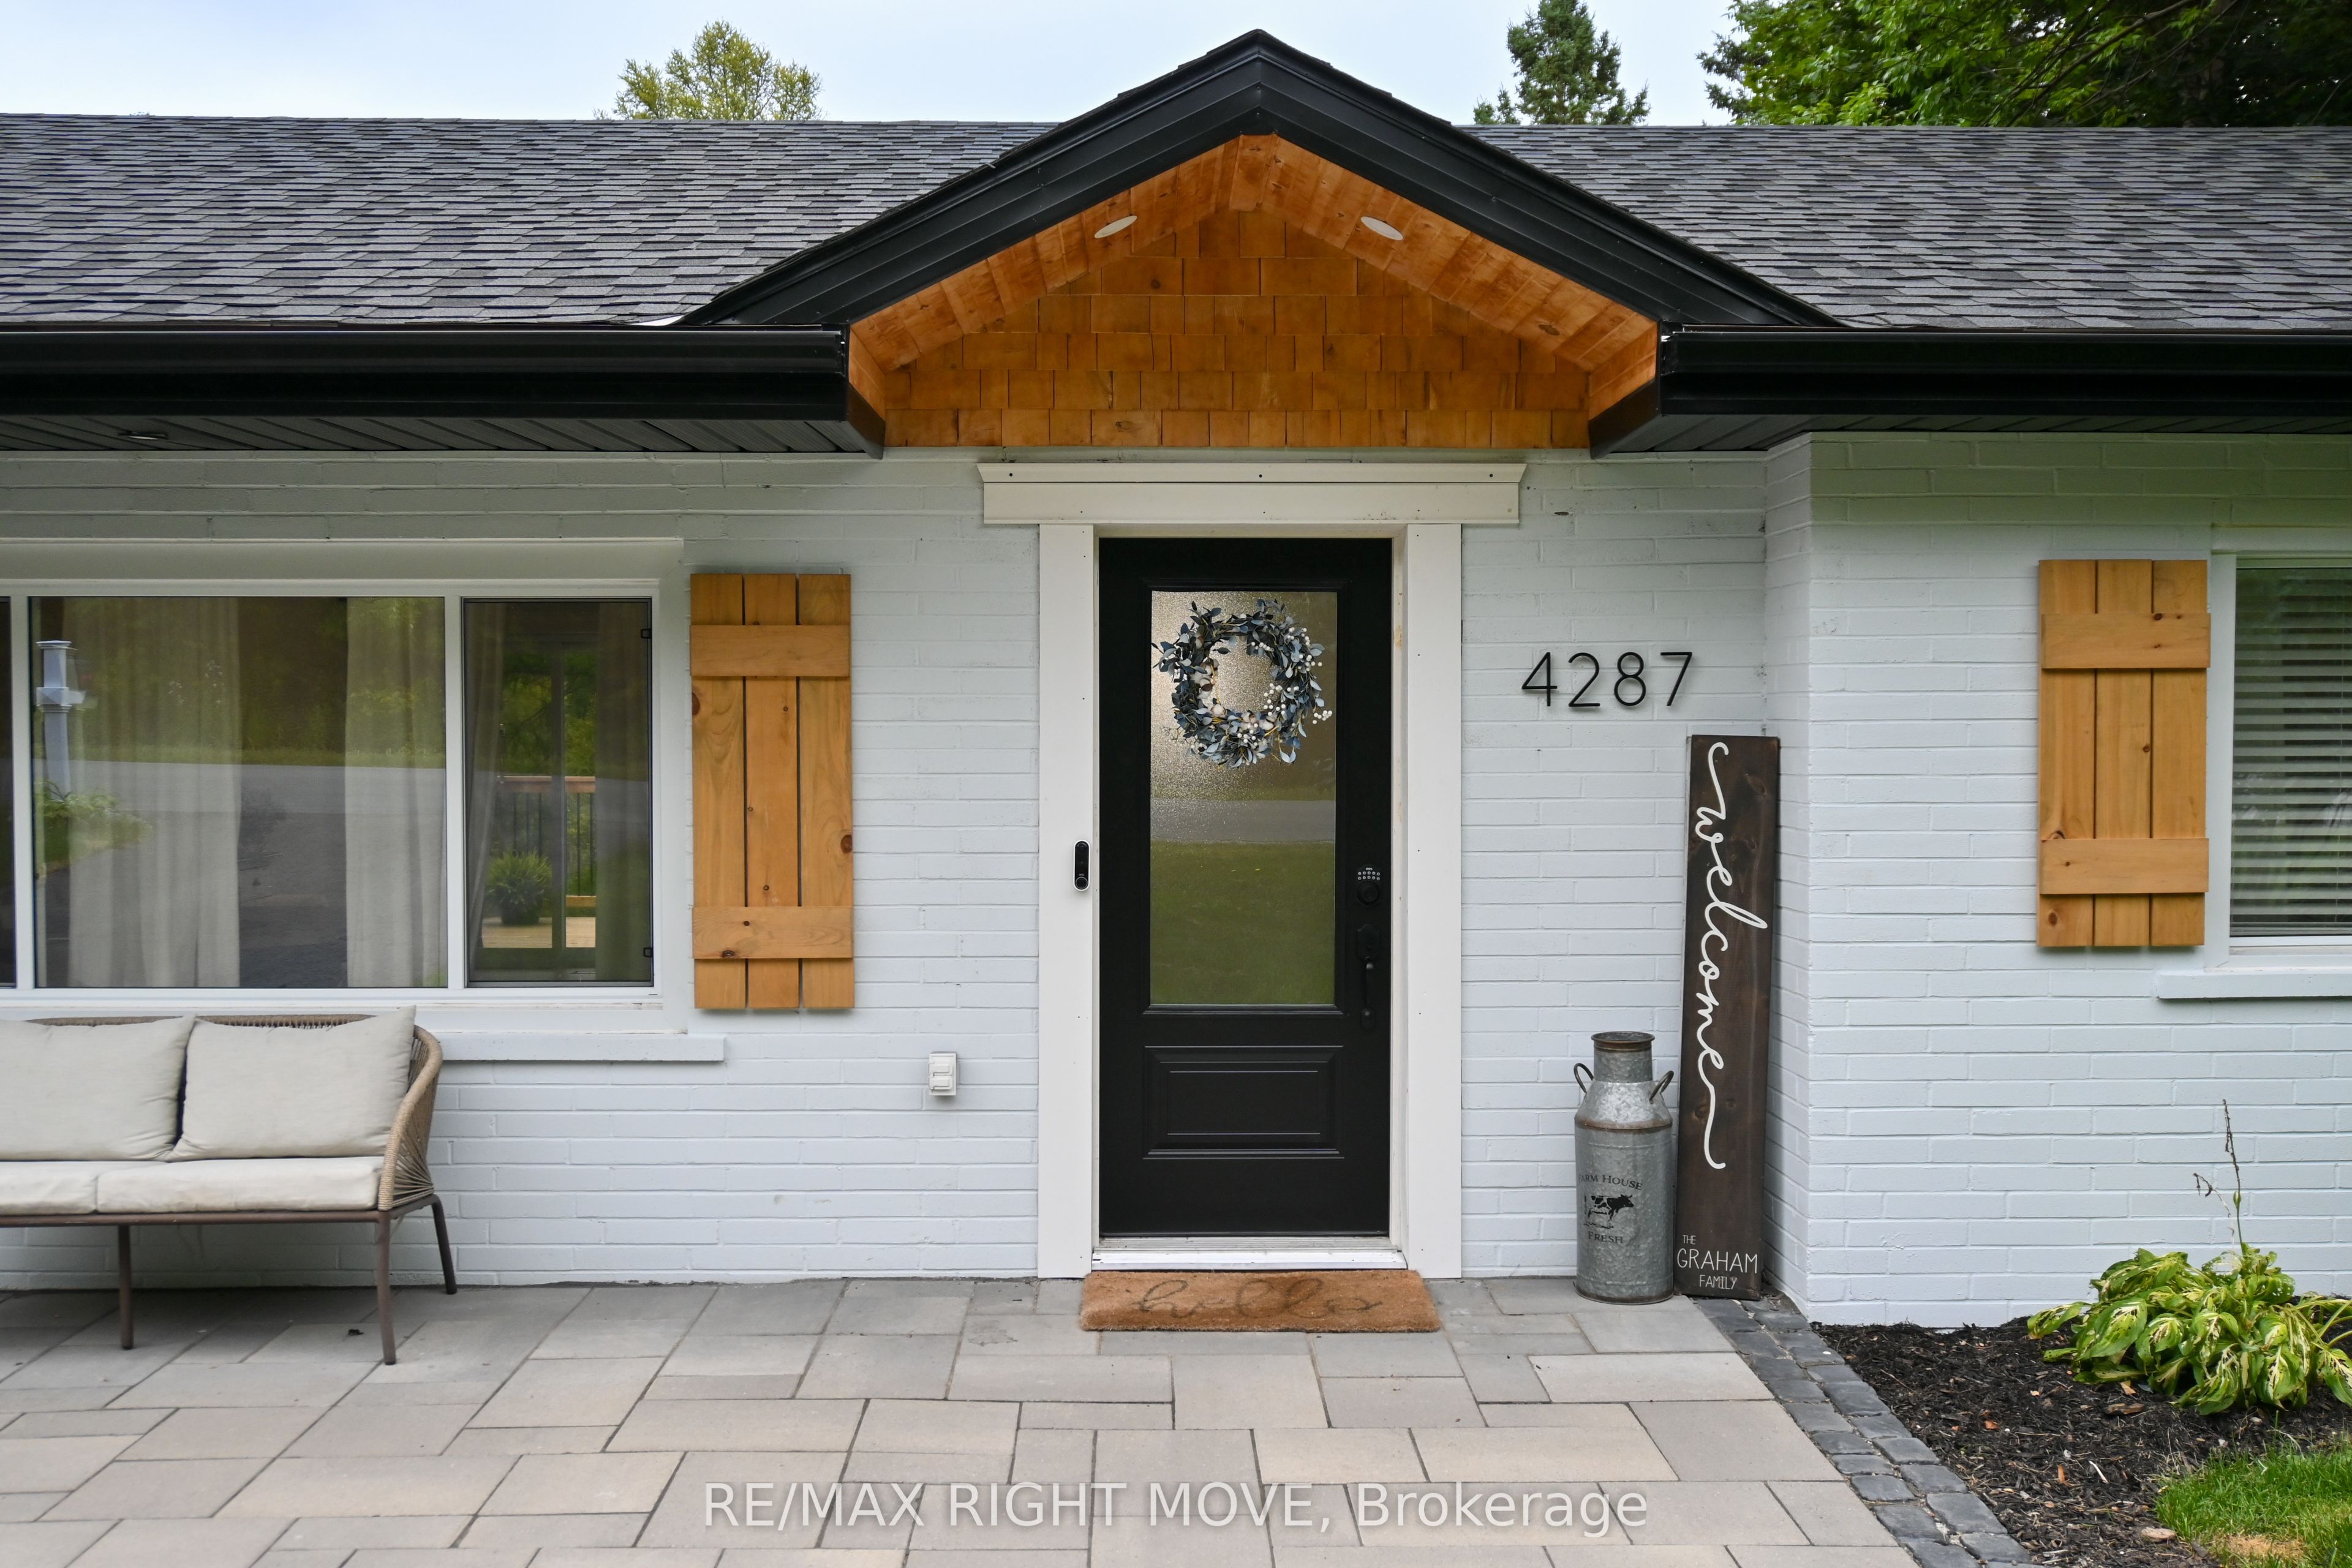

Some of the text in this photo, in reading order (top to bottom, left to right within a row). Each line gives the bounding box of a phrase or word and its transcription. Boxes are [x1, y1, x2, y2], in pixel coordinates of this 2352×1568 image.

[1521, 652, 1692, 707] 4287
[1695, 742, 1768, 1169] welcome
[1602, 1175, 1643, 1190] HOUSE
[1588, 1231, 1623, 1243] FRESH
[1683, 1234, 1697, 1245] THE
[1677, 1248, 1758, 1273] GRAHAM
[1699, 1275, 1738, 1289] FAMILY
